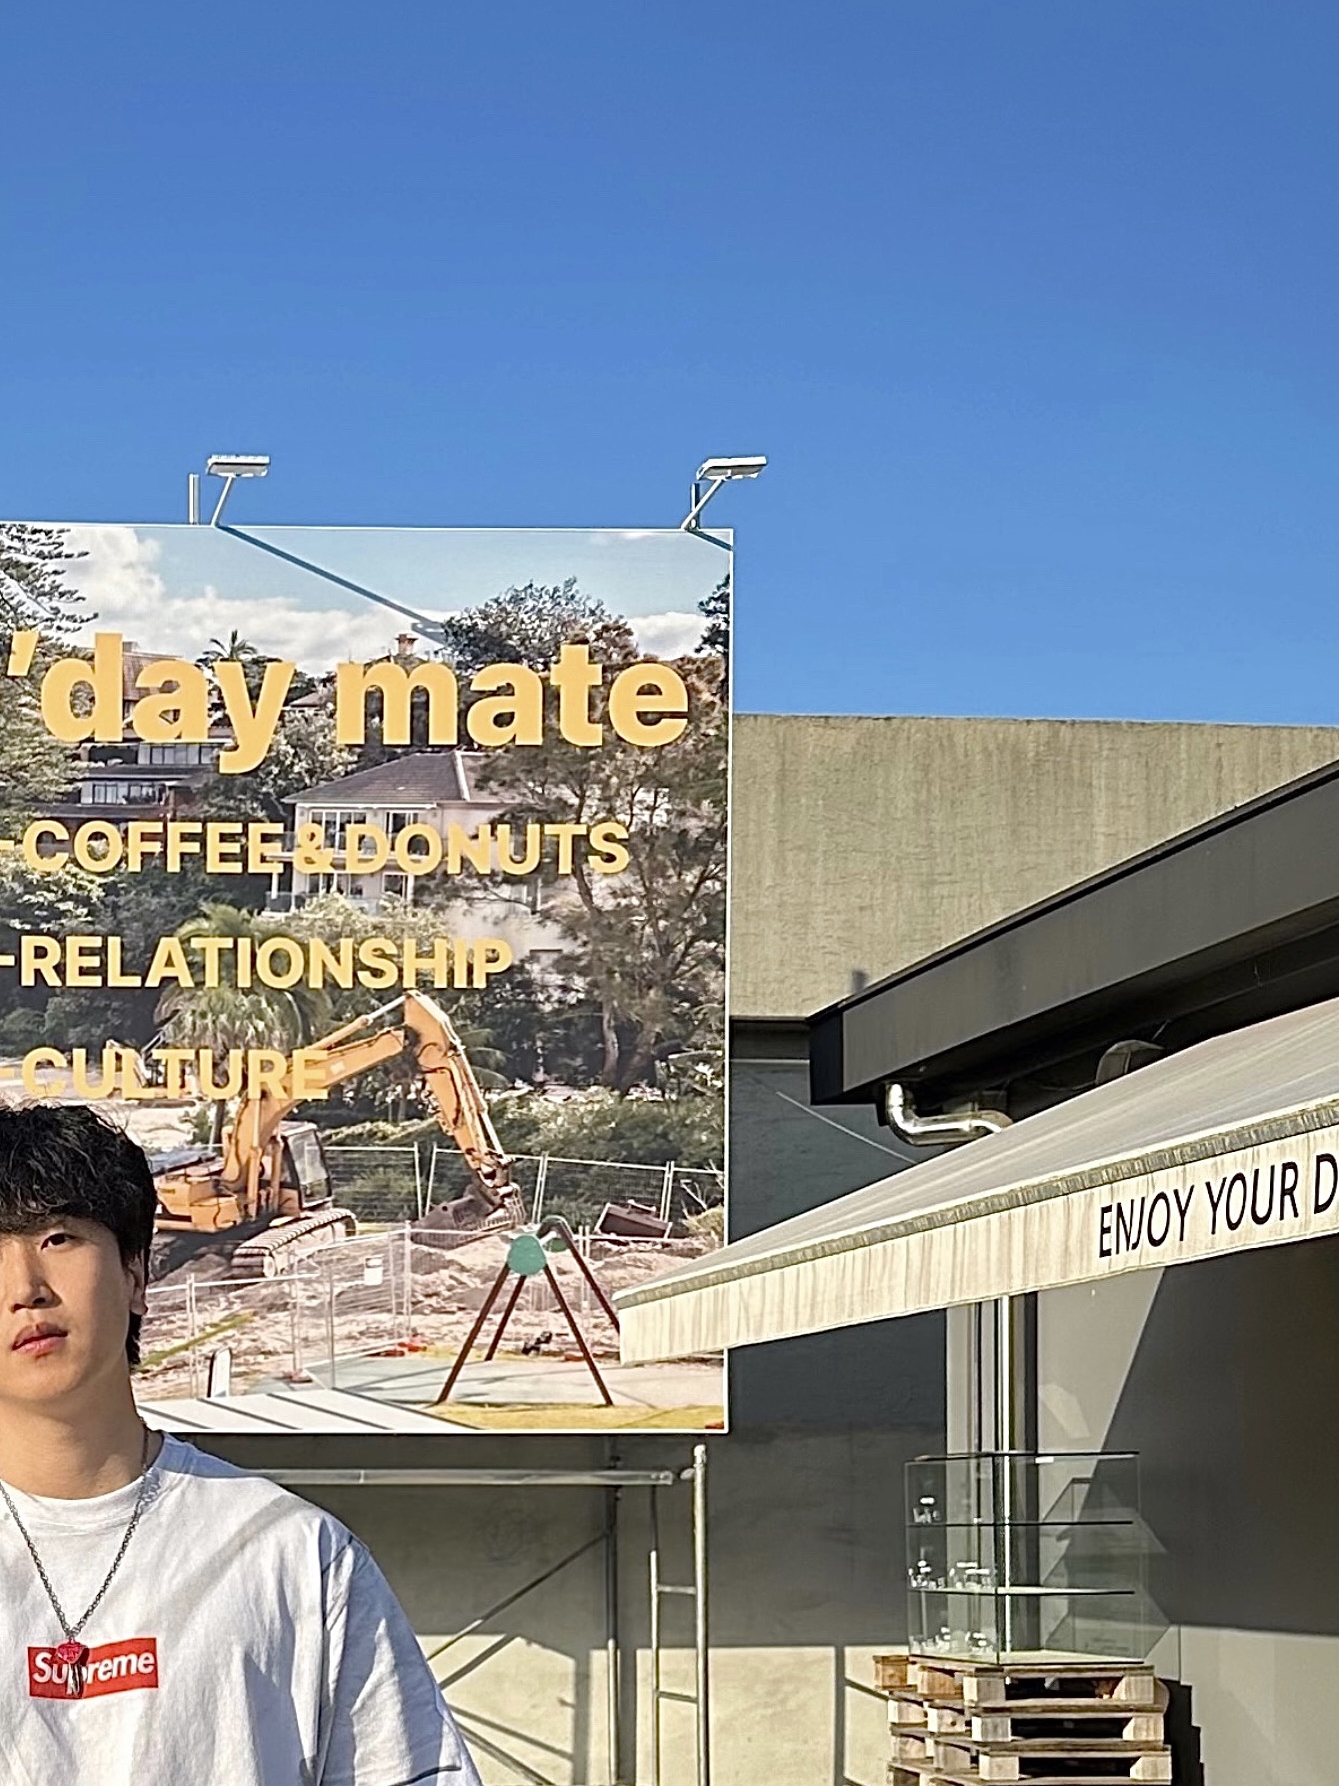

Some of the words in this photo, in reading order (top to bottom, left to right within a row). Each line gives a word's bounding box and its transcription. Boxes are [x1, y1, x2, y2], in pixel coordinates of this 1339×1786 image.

[336, 642, 690, 748] mate
[1098, 1184, 1195, 1258] ENJOY
[1205, 1161, 1299, 1235] YOUR
